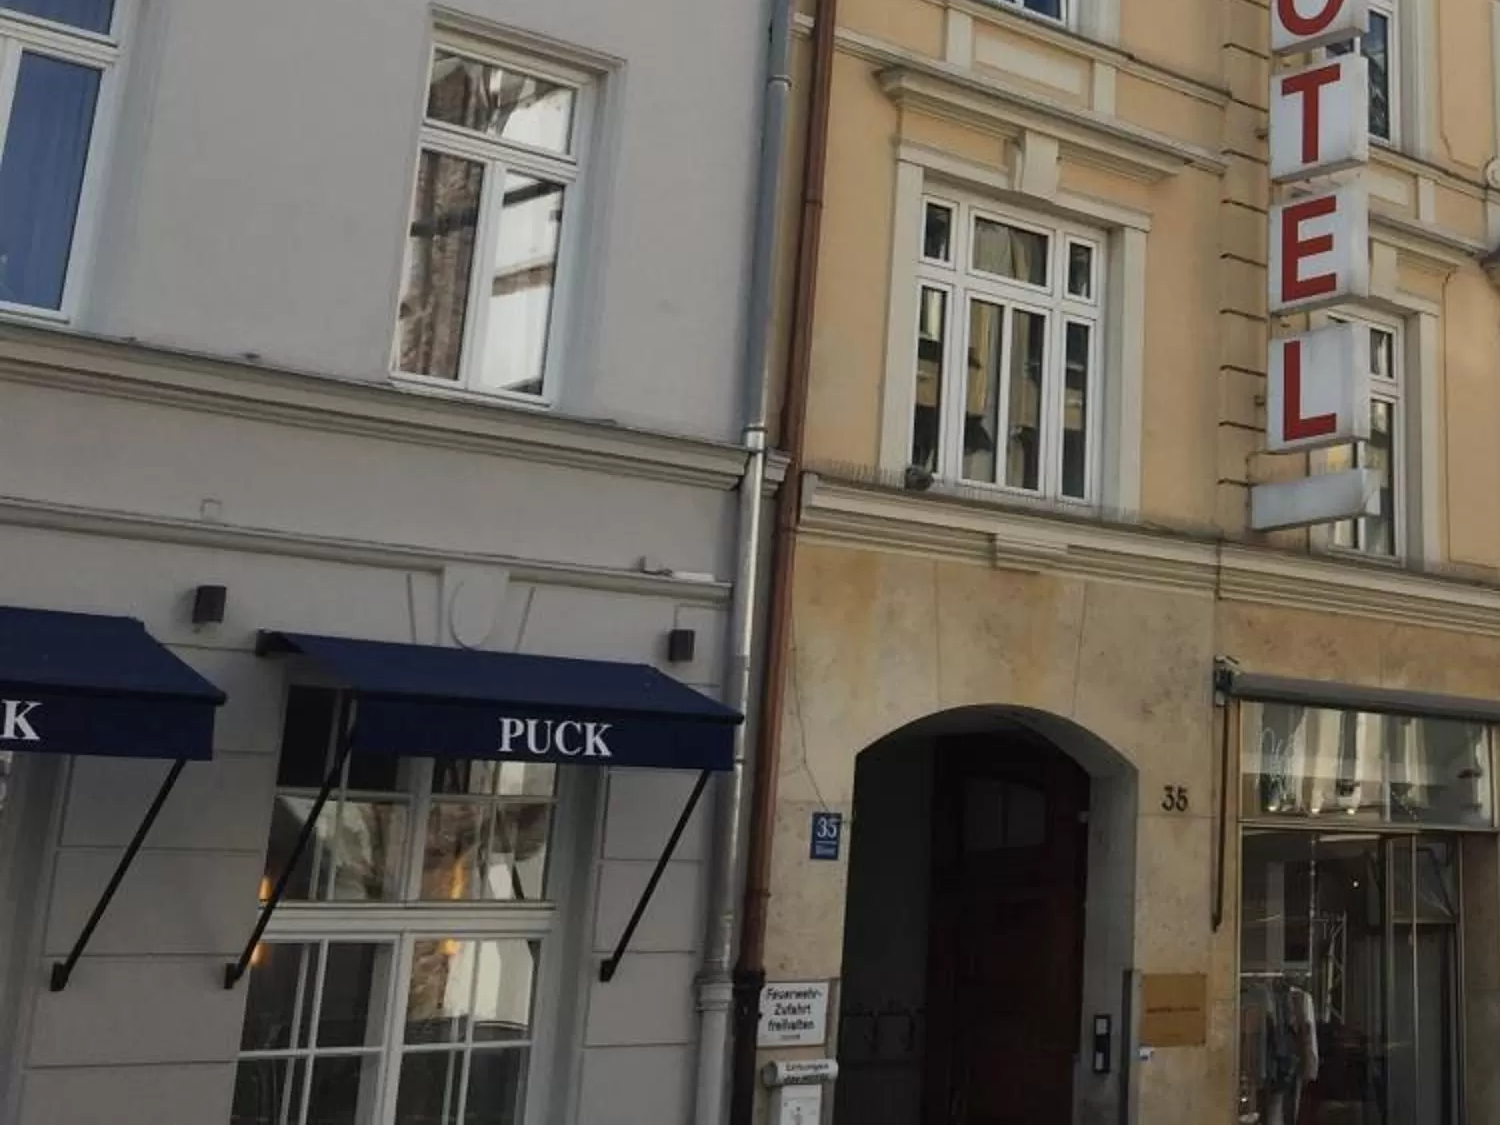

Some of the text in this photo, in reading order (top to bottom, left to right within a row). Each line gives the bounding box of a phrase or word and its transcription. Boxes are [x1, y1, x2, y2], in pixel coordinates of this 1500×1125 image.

[498, 716, 614, 757] PUCK
[1161, 785, 1189, 812] 35
[816, 816, 842, 839] 35
[773, 1002, 812, 1016] Zufahrt
